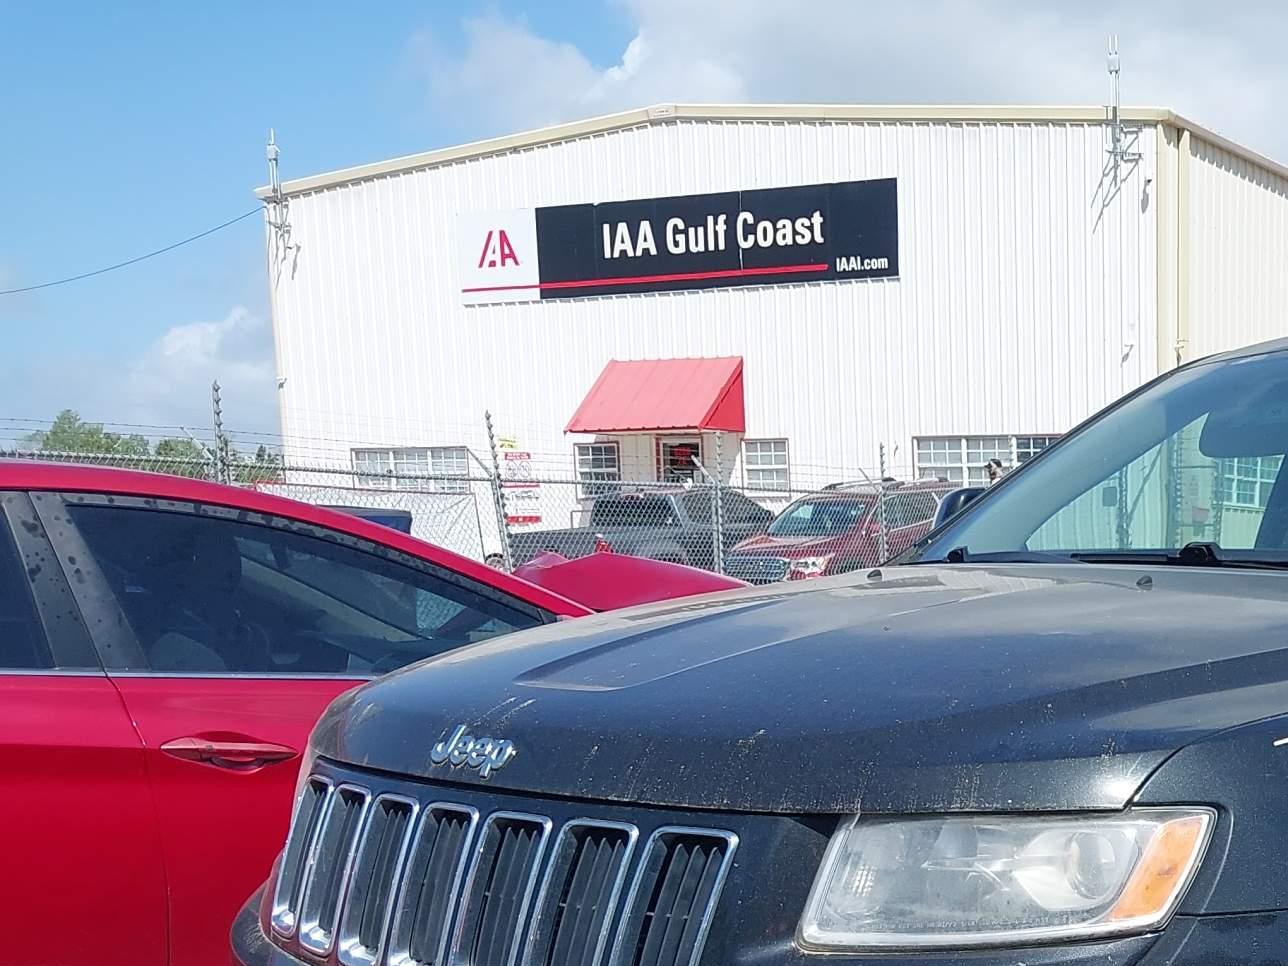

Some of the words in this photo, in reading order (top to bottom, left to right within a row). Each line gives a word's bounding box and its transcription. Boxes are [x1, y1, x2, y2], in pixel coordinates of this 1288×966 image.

[602, 220, 659, 259] IAA
[666, 213, 728, 254] Gulf
[737, 210, 825, 249] Coast
[835, 257, 889, 273] IAAI.com
[431, 724, 517, 779] Jeep
